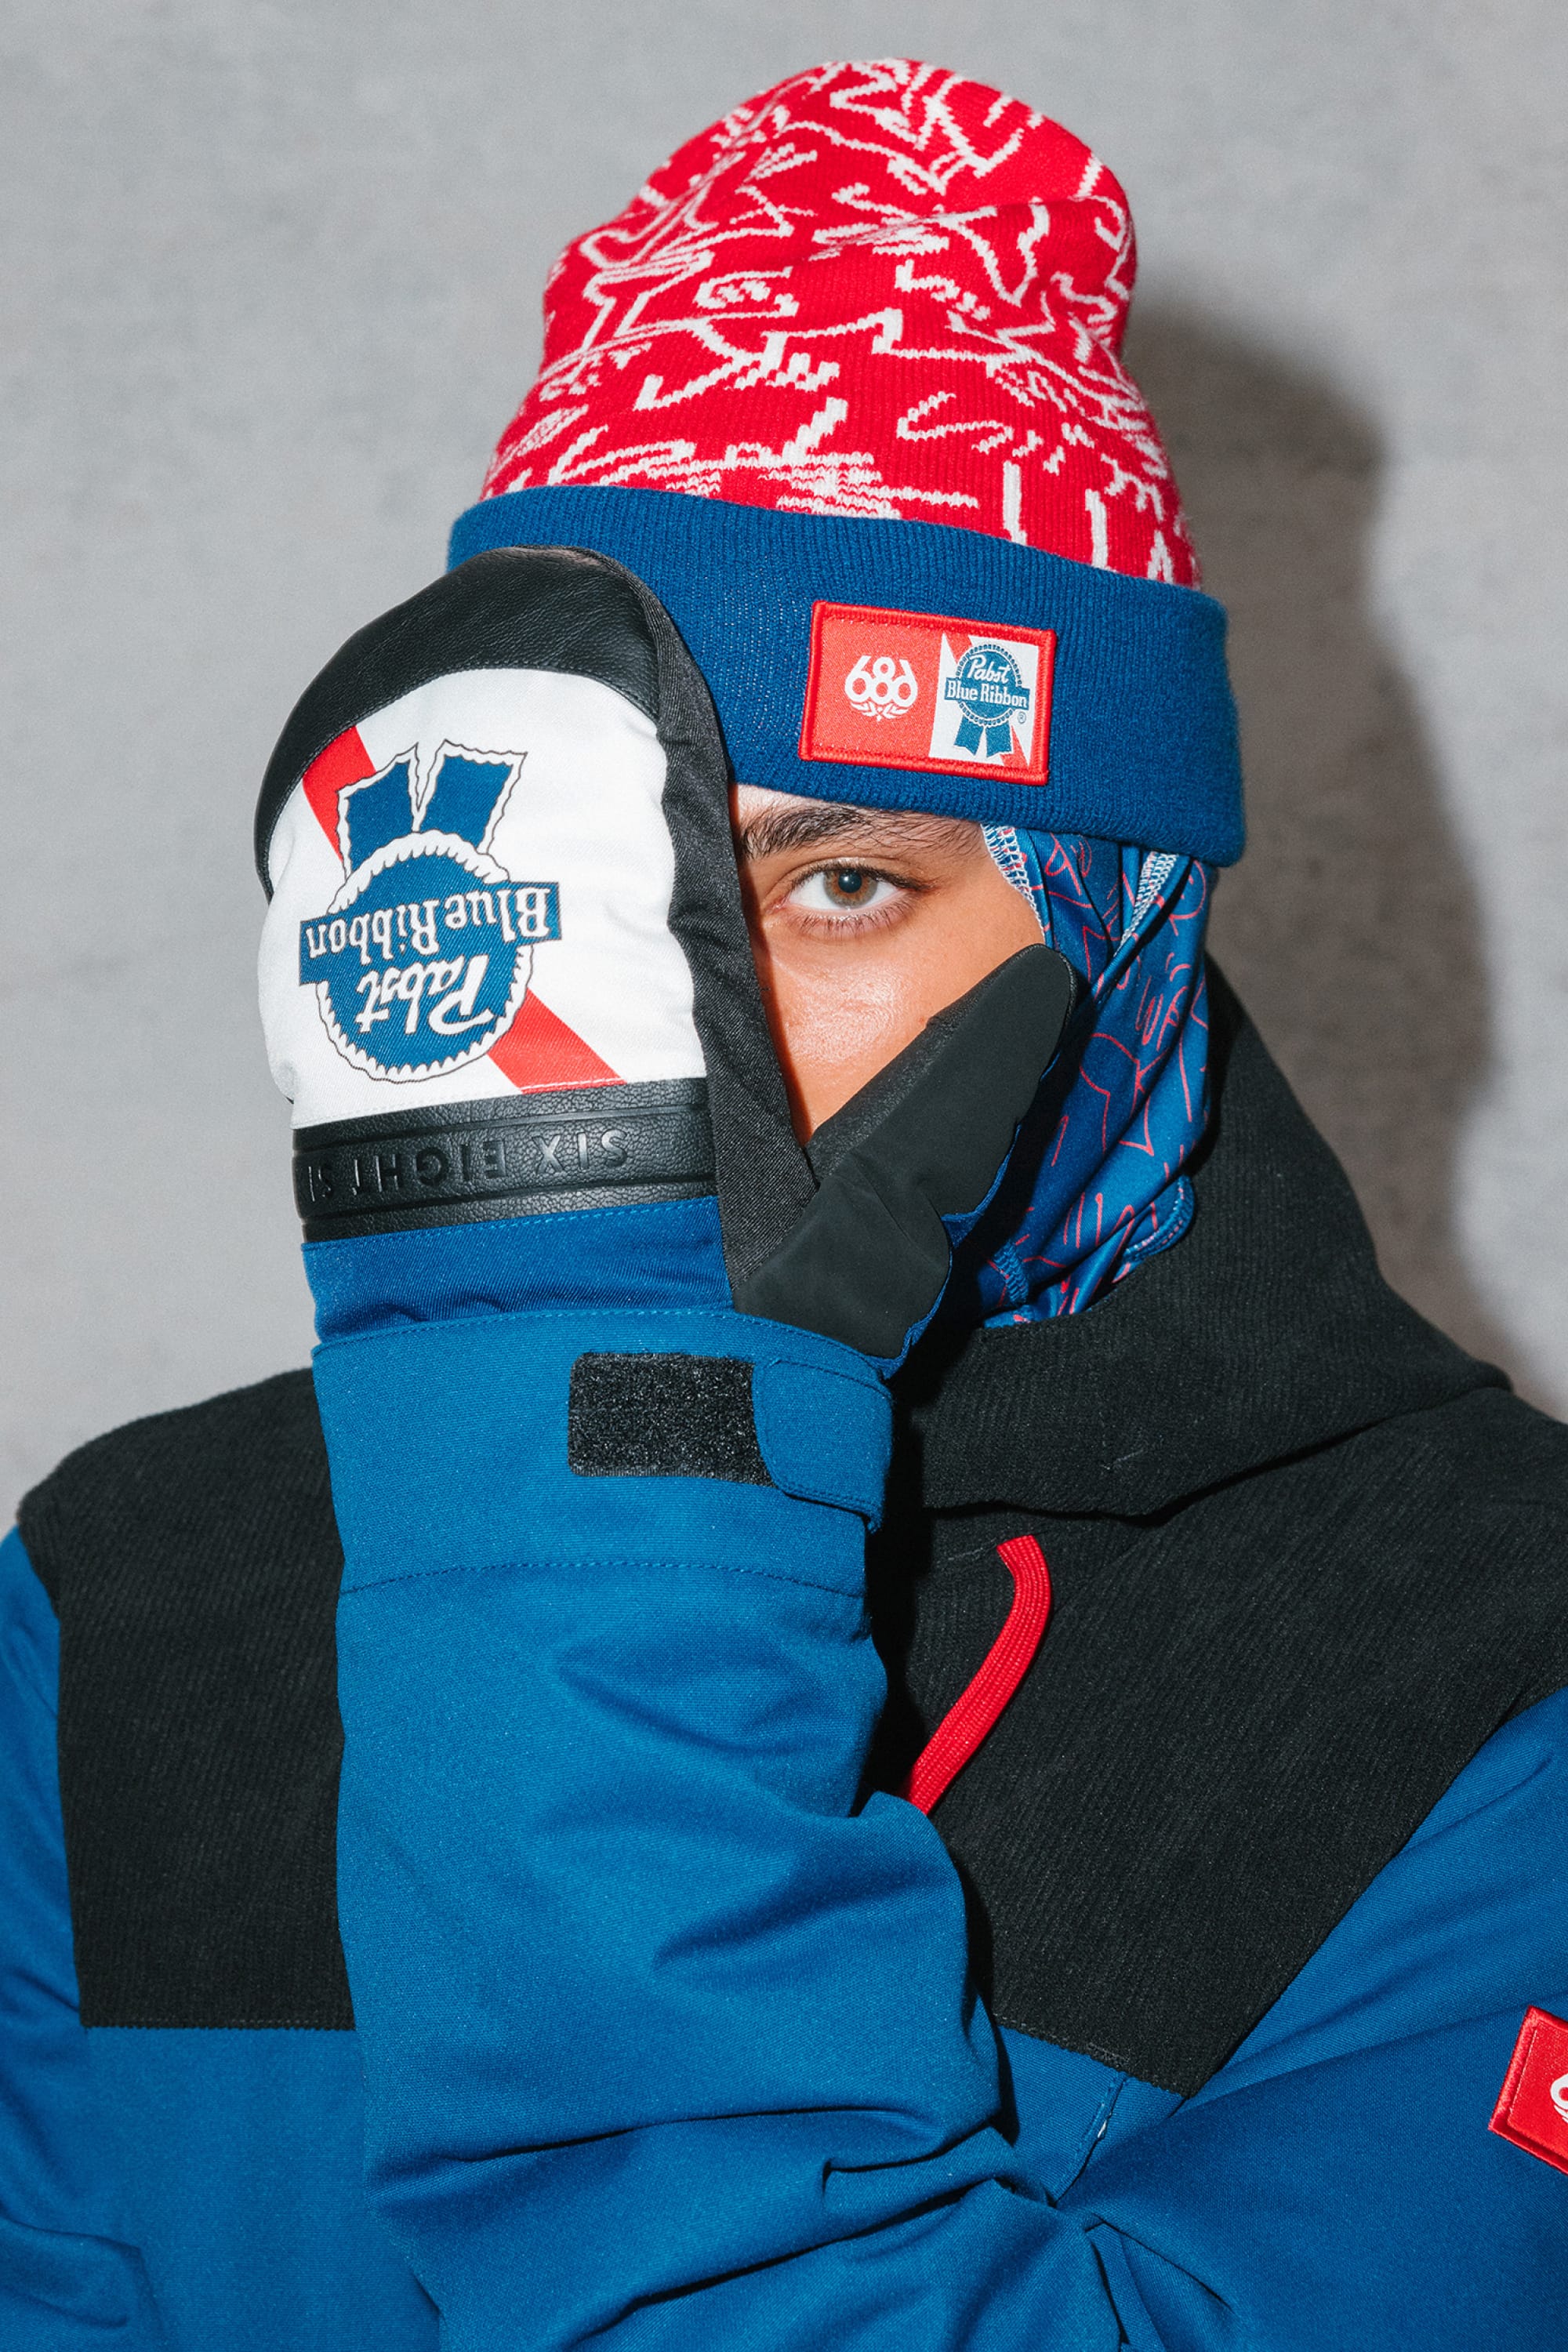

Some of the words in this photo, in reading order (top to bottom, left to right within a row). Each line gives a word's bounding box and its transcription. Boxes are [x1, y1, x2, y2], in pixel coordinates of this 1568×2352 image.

[946, 681, 978, 701] Blue
[980, 684, 1027, 708] Ribbon
[967, 655, 1011, 684] Pabst
[306, 899, 439, 965] Ribbon
[444, 887, 552, 943] Blue
[355, 954, 495, 1036] Pabst
[351, 1139, 510, 1196] EIGHT
[532, 1128, 628, 1175] SIX
[307, 1164, 333, 1202] SI
